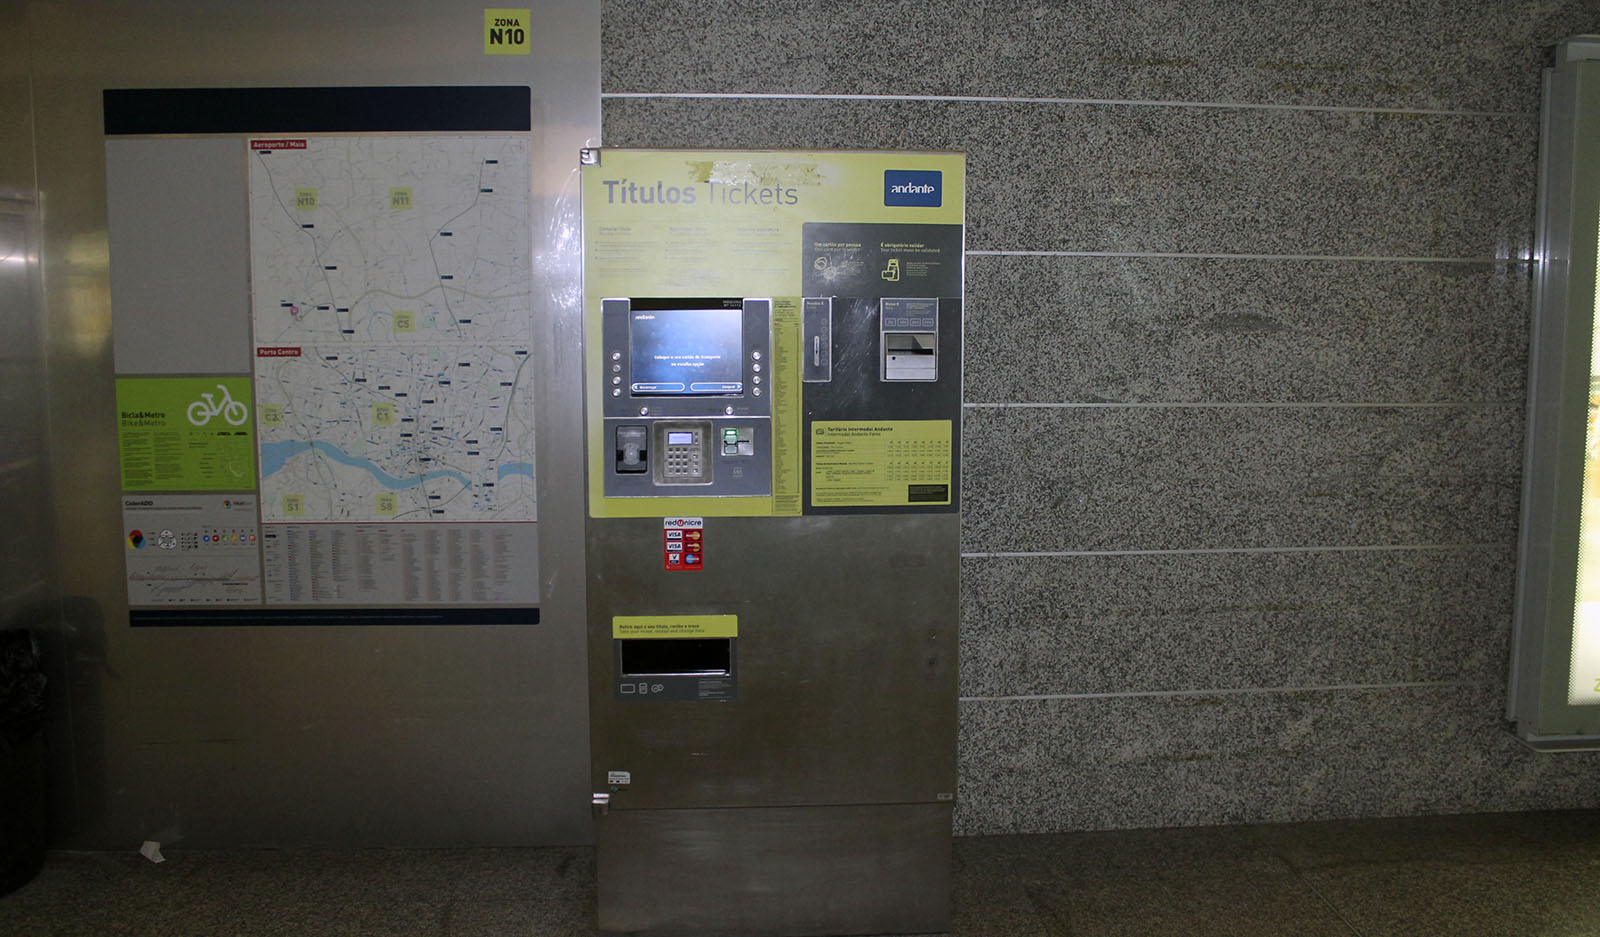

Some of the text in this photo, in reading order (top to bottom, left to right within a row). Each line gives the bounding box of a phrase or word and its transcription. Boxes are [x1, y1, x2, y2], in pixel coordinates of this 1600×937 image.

[494, 18, 520, 27] ZONA
[490, 28, 525, 45] N10
[253, 142, 285, 150] Aeroporto
[602, 178, 799, 205] Títulos Tickets
[891, 182, 935, 194] andante
[392, 197, 409, 206] N11
